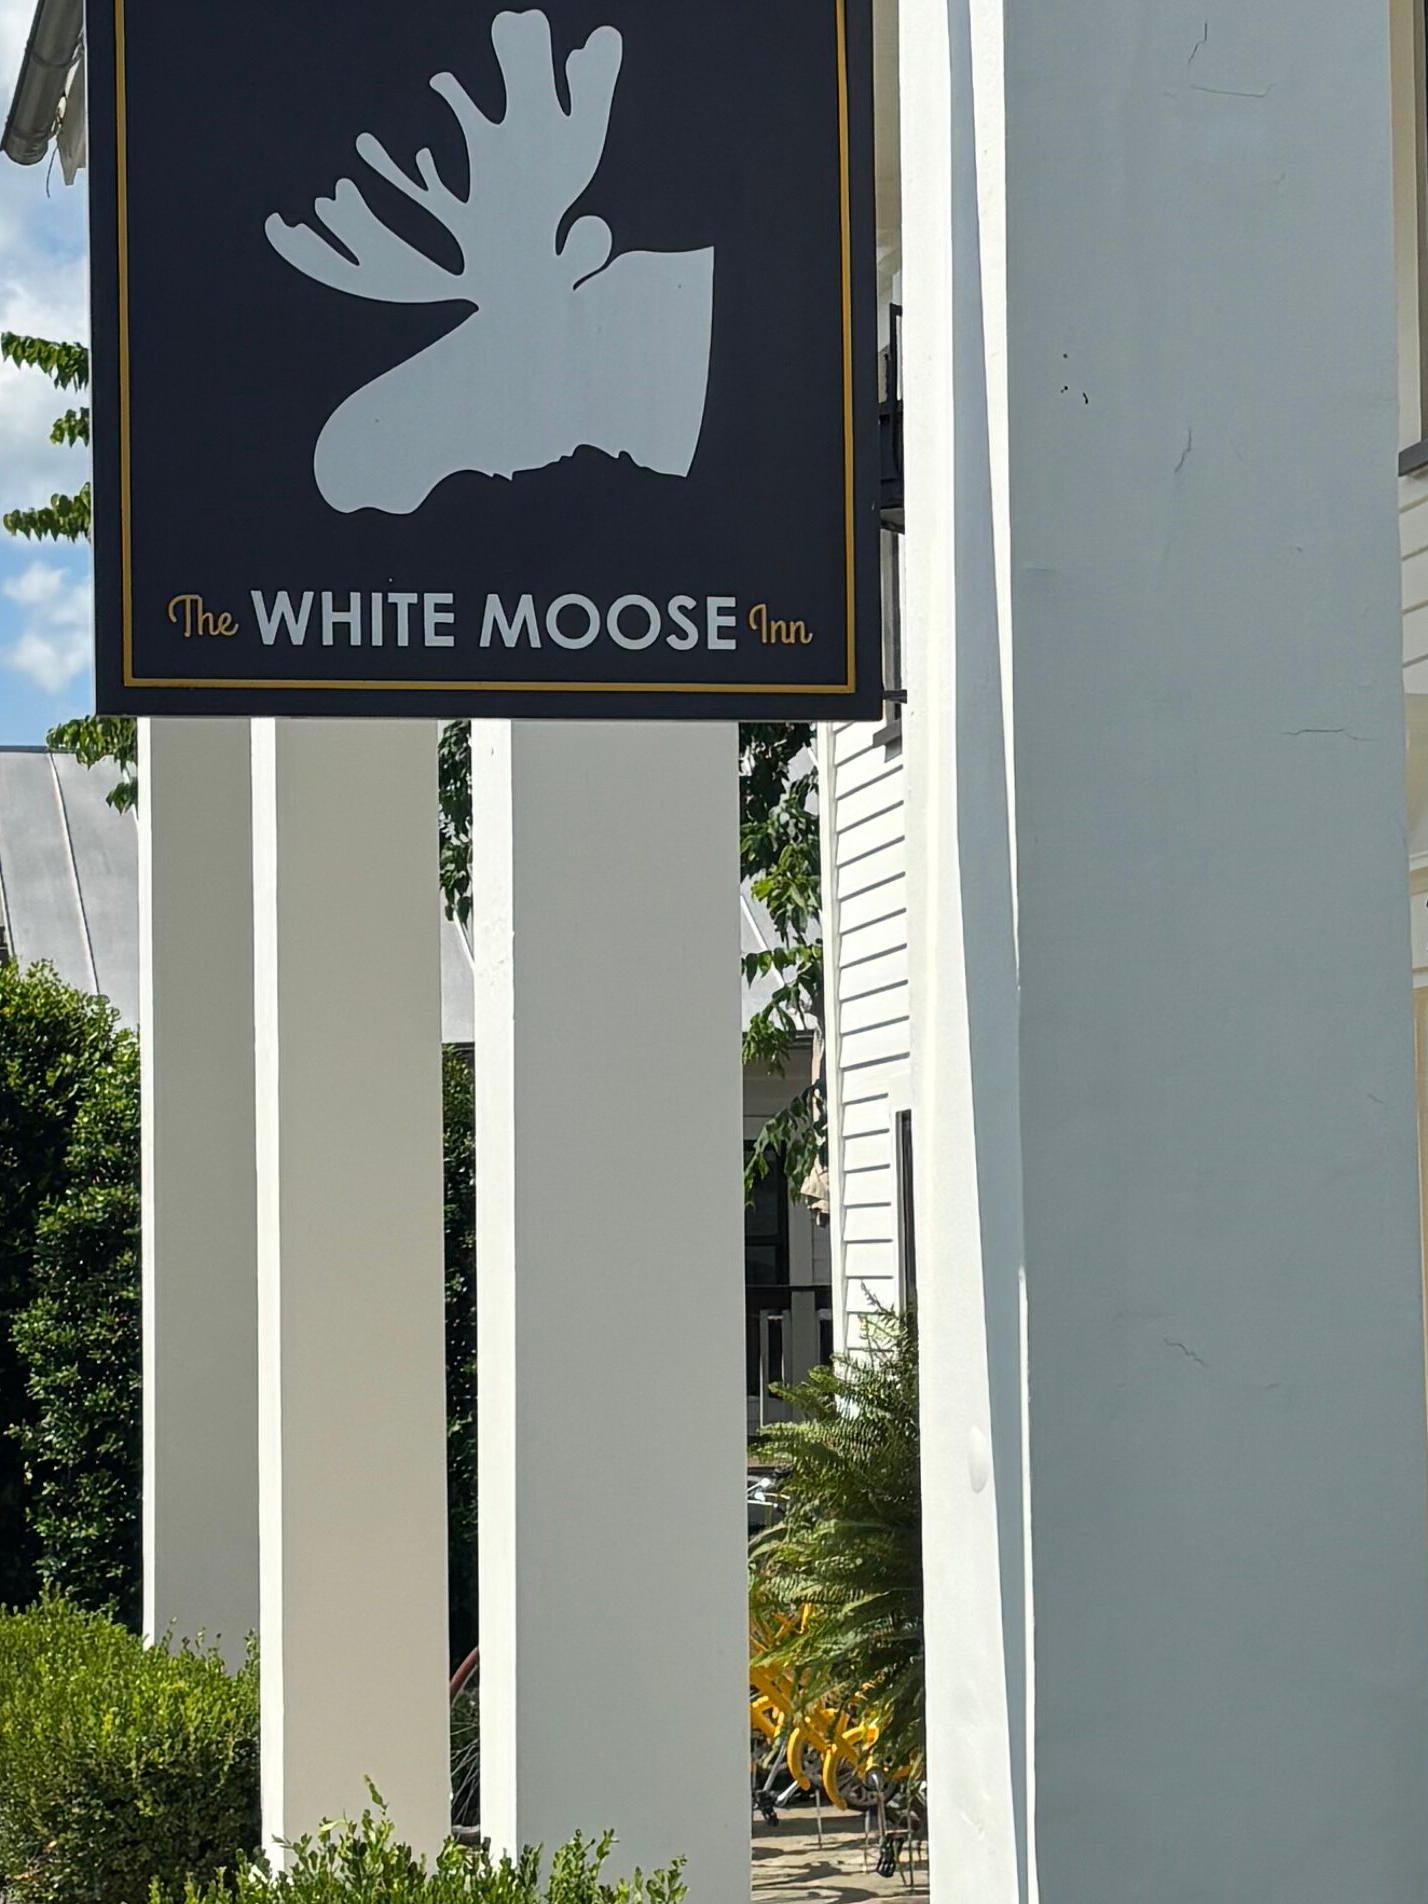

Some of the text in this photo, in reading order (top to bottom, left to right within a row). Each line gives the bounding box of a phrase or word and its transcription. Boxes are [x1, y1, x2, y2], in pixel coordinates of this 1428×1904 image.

[168, 590, 814, 651] The WHITE MOOSE Inn
